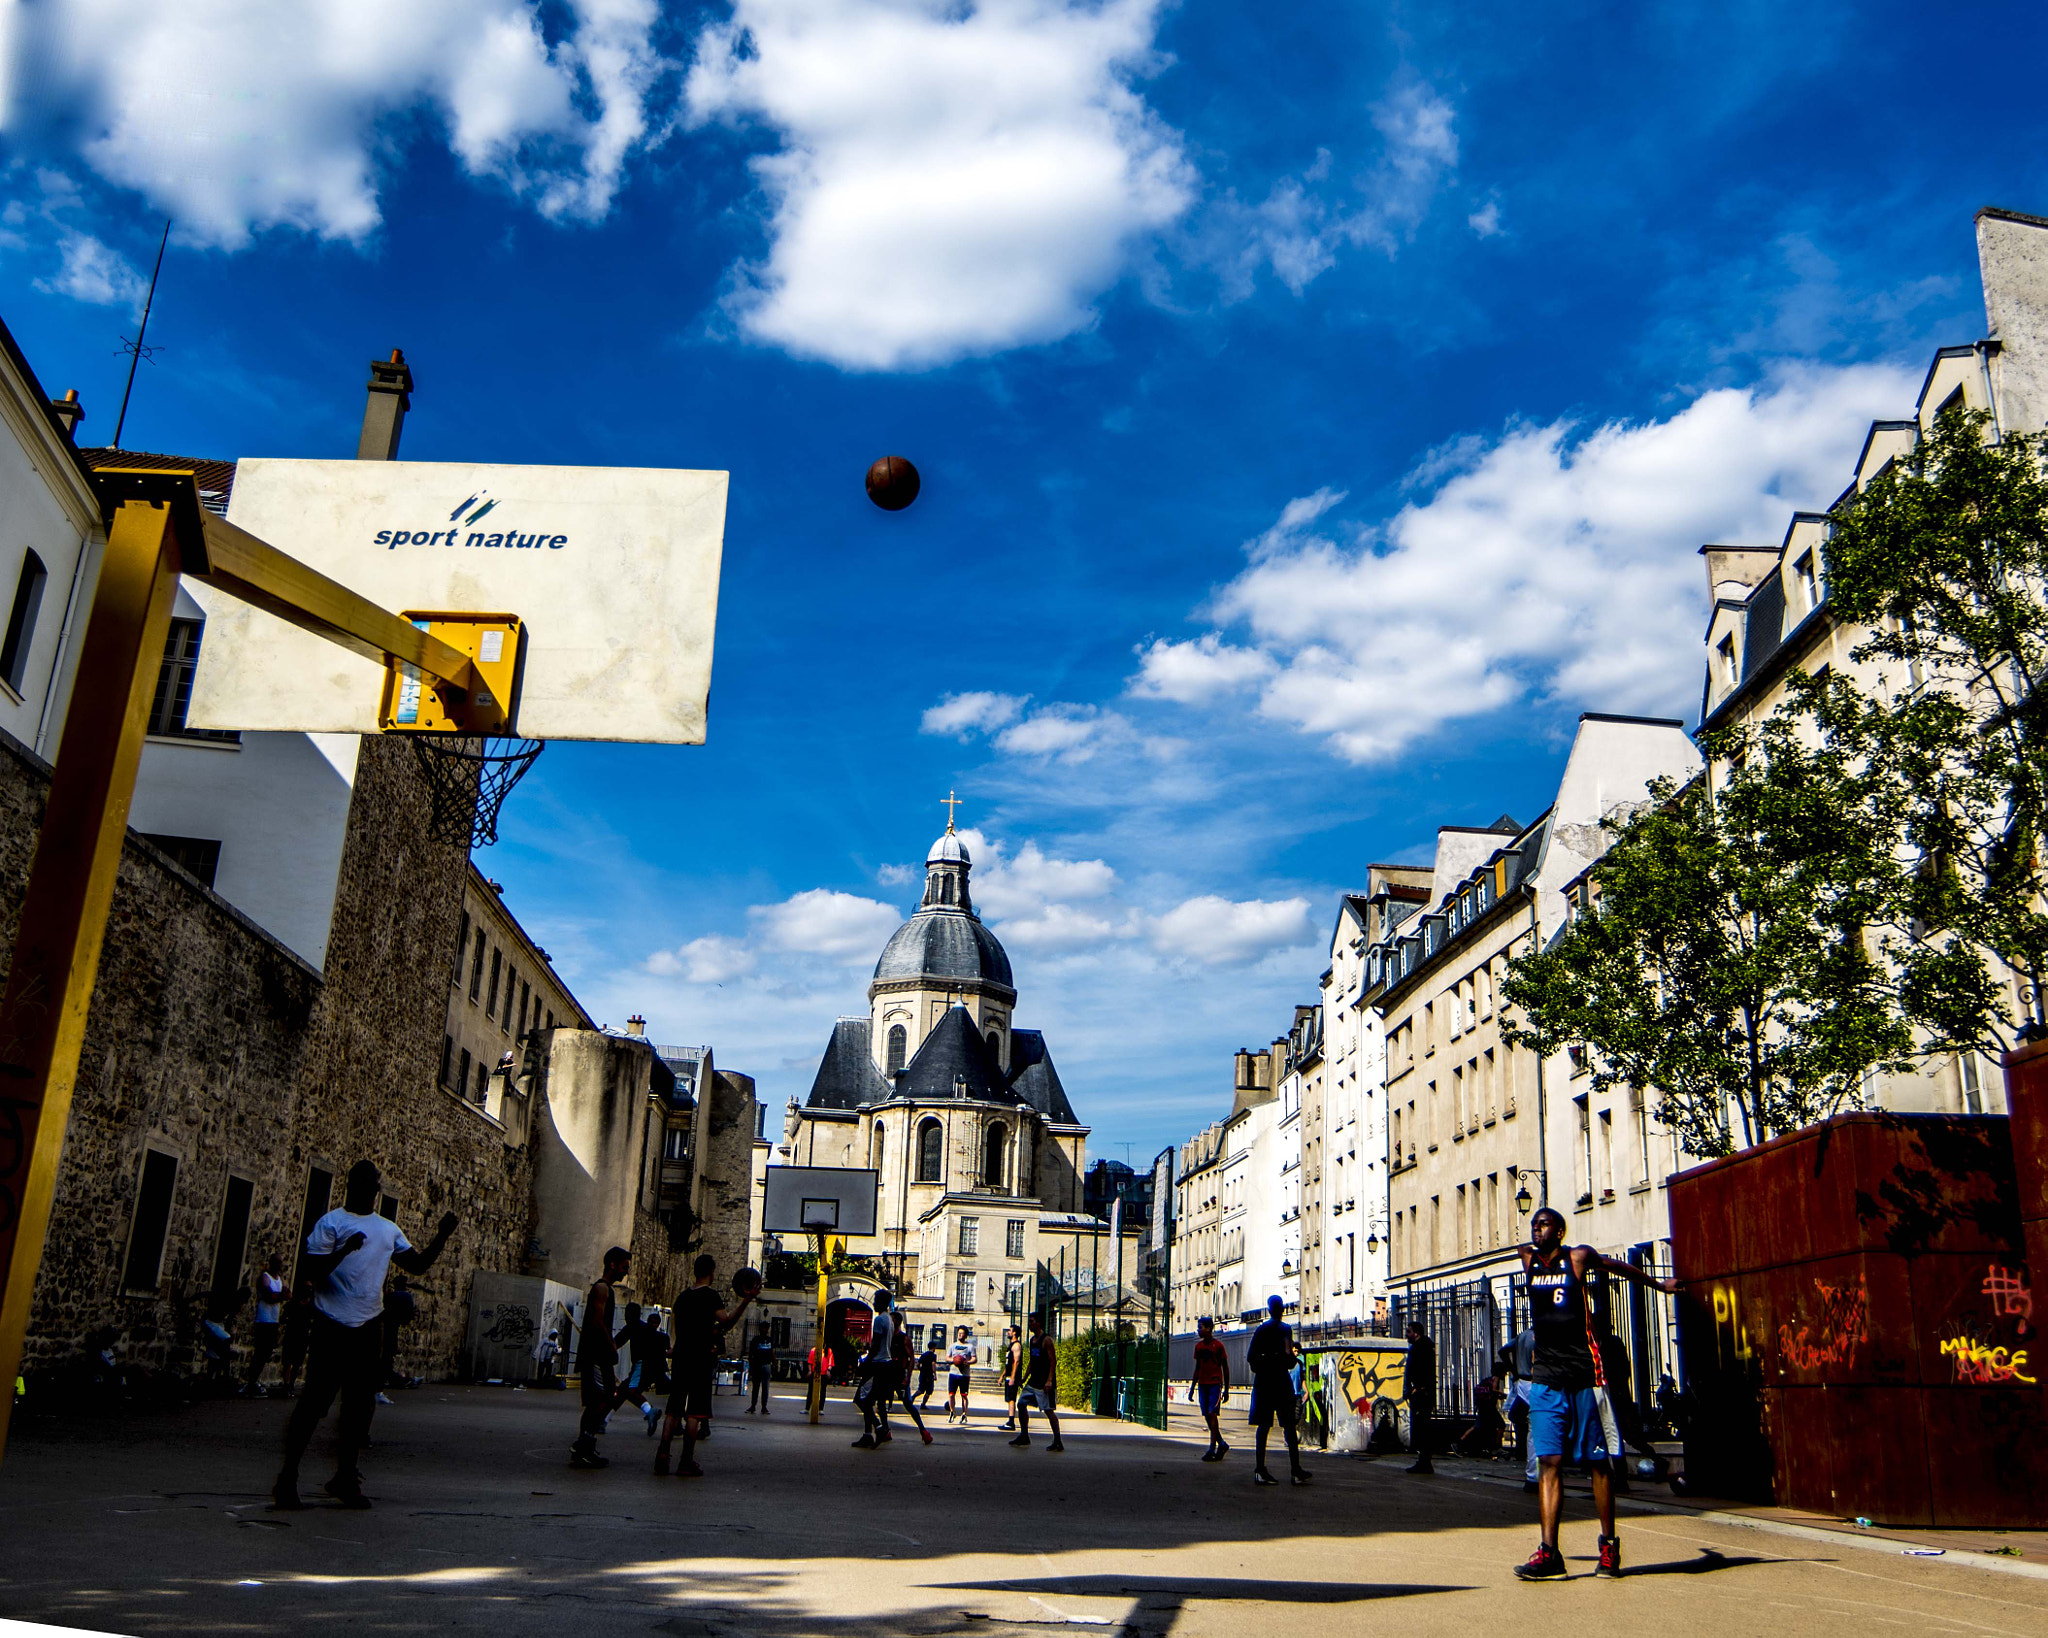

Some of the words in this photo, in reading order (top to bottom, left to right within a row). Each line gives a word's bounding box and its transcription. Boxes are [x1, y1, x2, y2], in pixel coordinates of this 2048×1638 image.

[373, 528, 458, 549] sport
[465, 530, 568, 549] nature
[1531, 1273, 1567, 1286] MIAMI
[1553, 1288, 1565, 1304] 6
